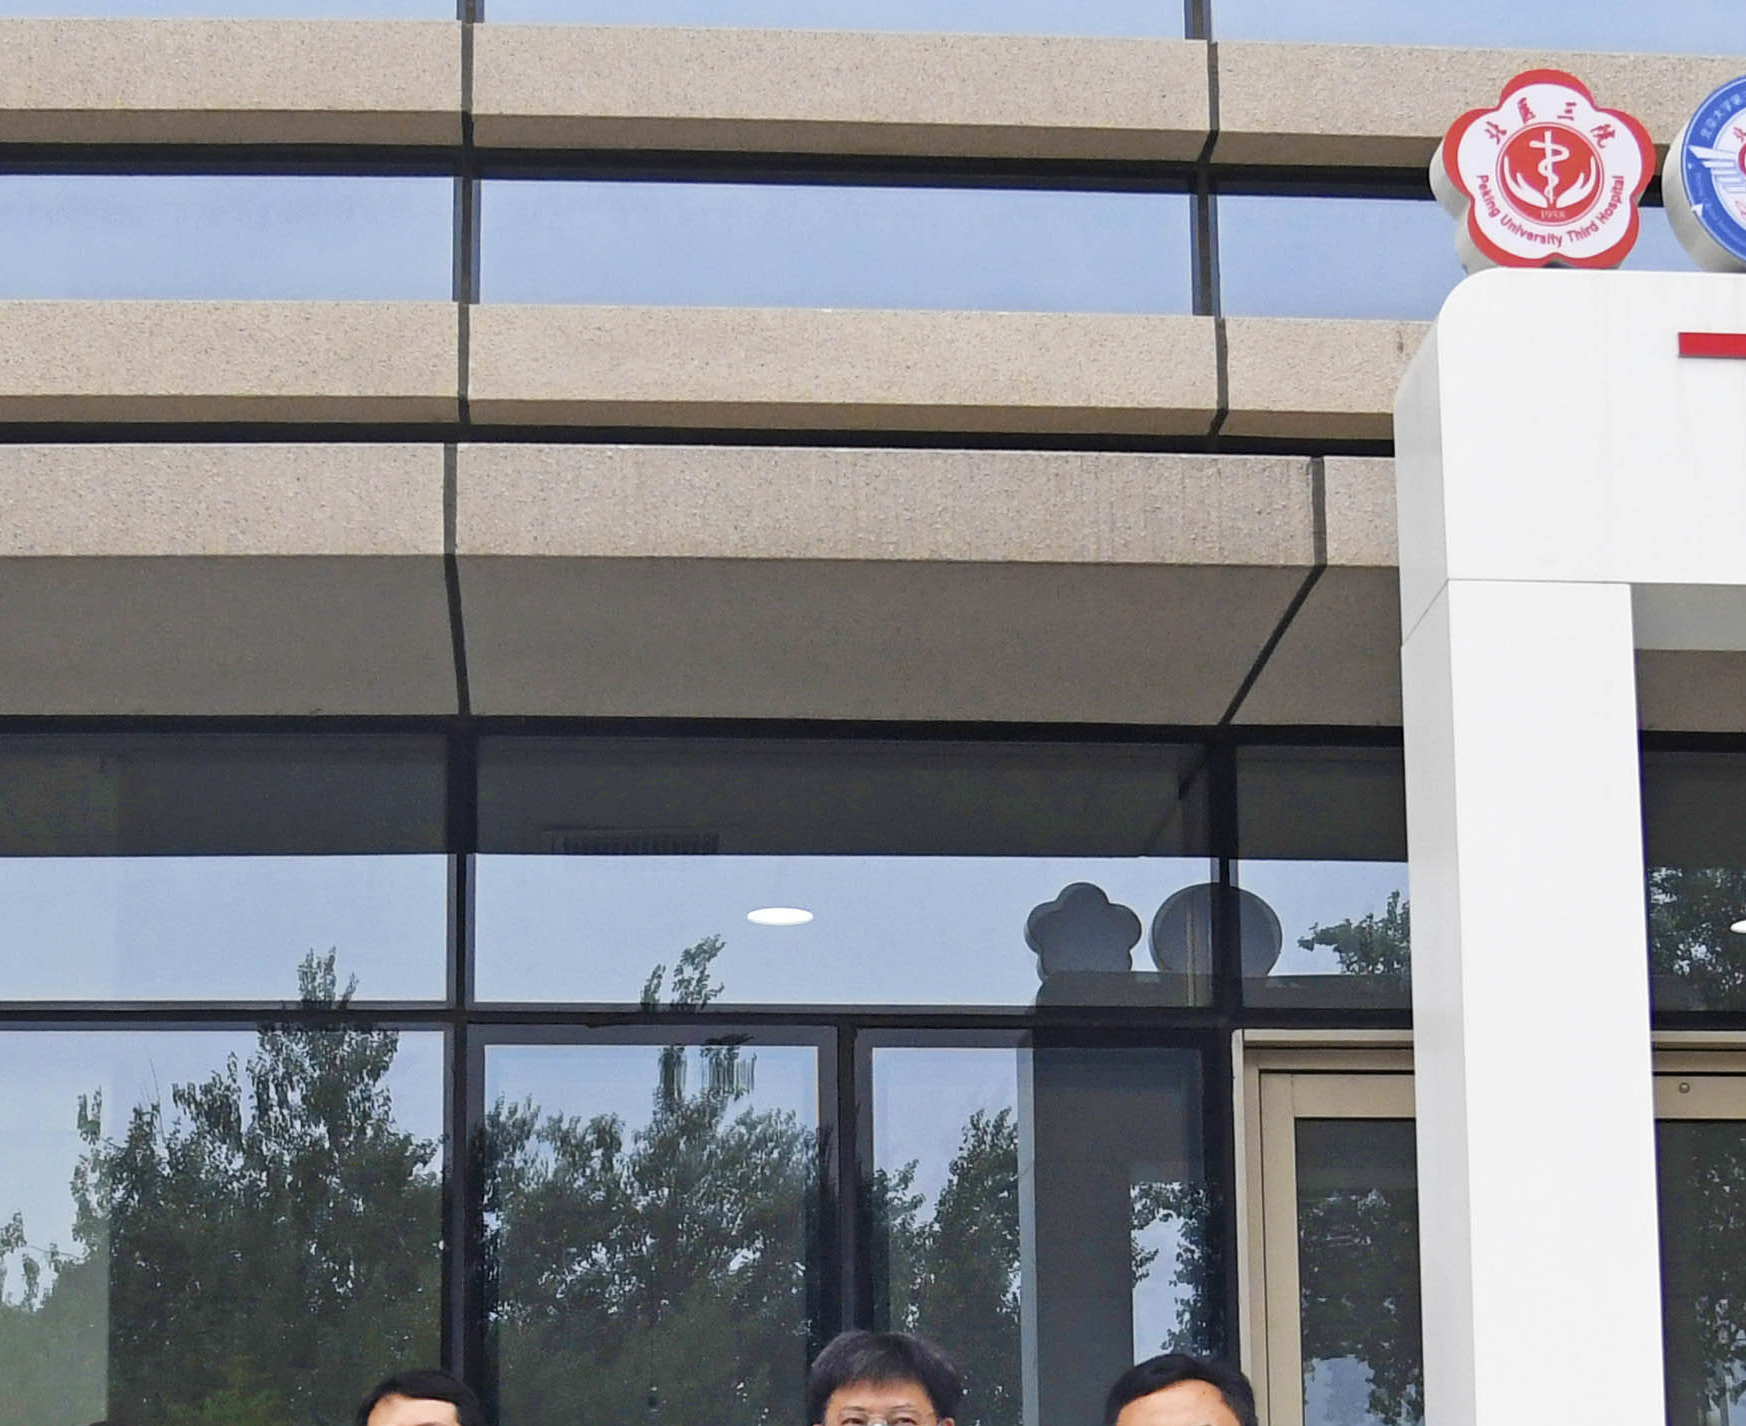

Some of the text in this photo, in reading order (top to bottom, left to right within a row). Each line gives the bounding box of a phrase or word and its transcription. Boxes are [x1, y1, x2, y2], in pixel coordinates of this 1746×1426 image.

[1477, 174, 1625, 248] Peking University Third Hospital
